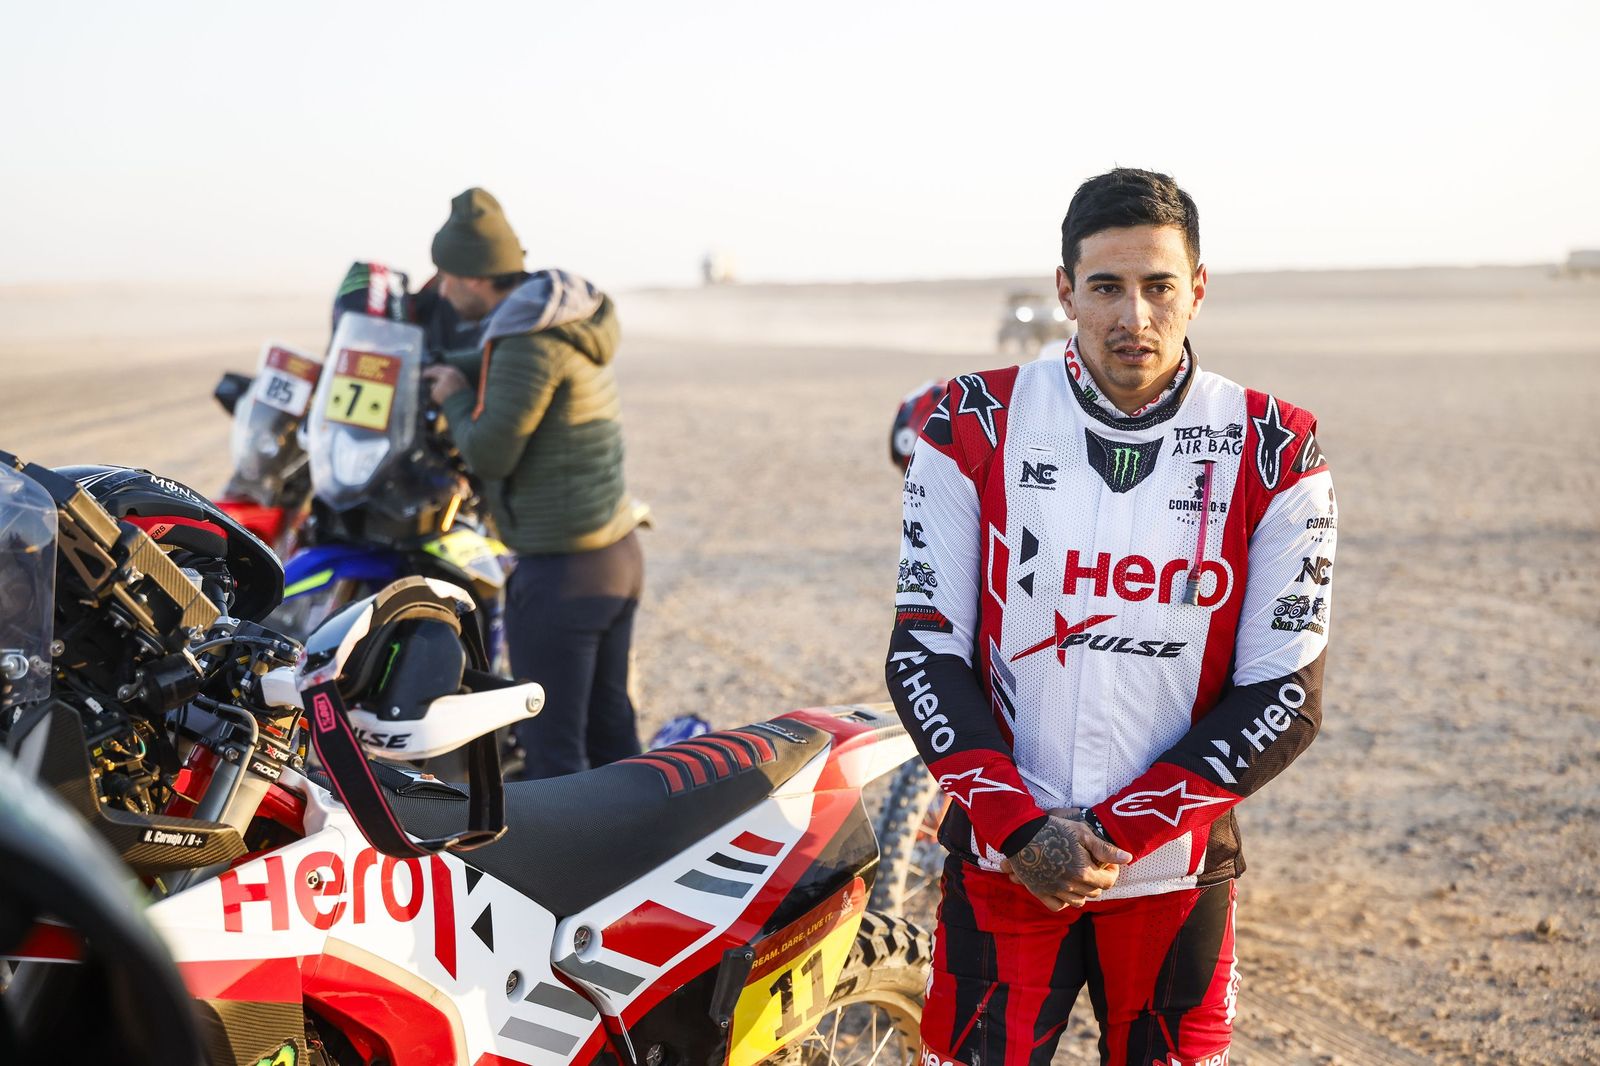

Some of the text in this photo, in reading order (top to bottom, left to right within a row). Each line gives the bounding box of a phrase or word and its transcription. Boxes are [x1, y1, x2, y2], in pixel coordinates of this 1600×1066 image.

[346, 383, 363, 417] 7
[1020, 460, 1059, 485] NC
[1172, 438, 1244, 457] AIR BAG
[1062, 549, 1230, 607] Hero
[1294, 556, 1333, 586] NC
[902, 669, 956, 754] Hero
[216, 846, 425, 933] Hero
[752, 912, 834, 969] REAM. DARE. LIVE IT.
[769, 948, 826, 1041] 11
